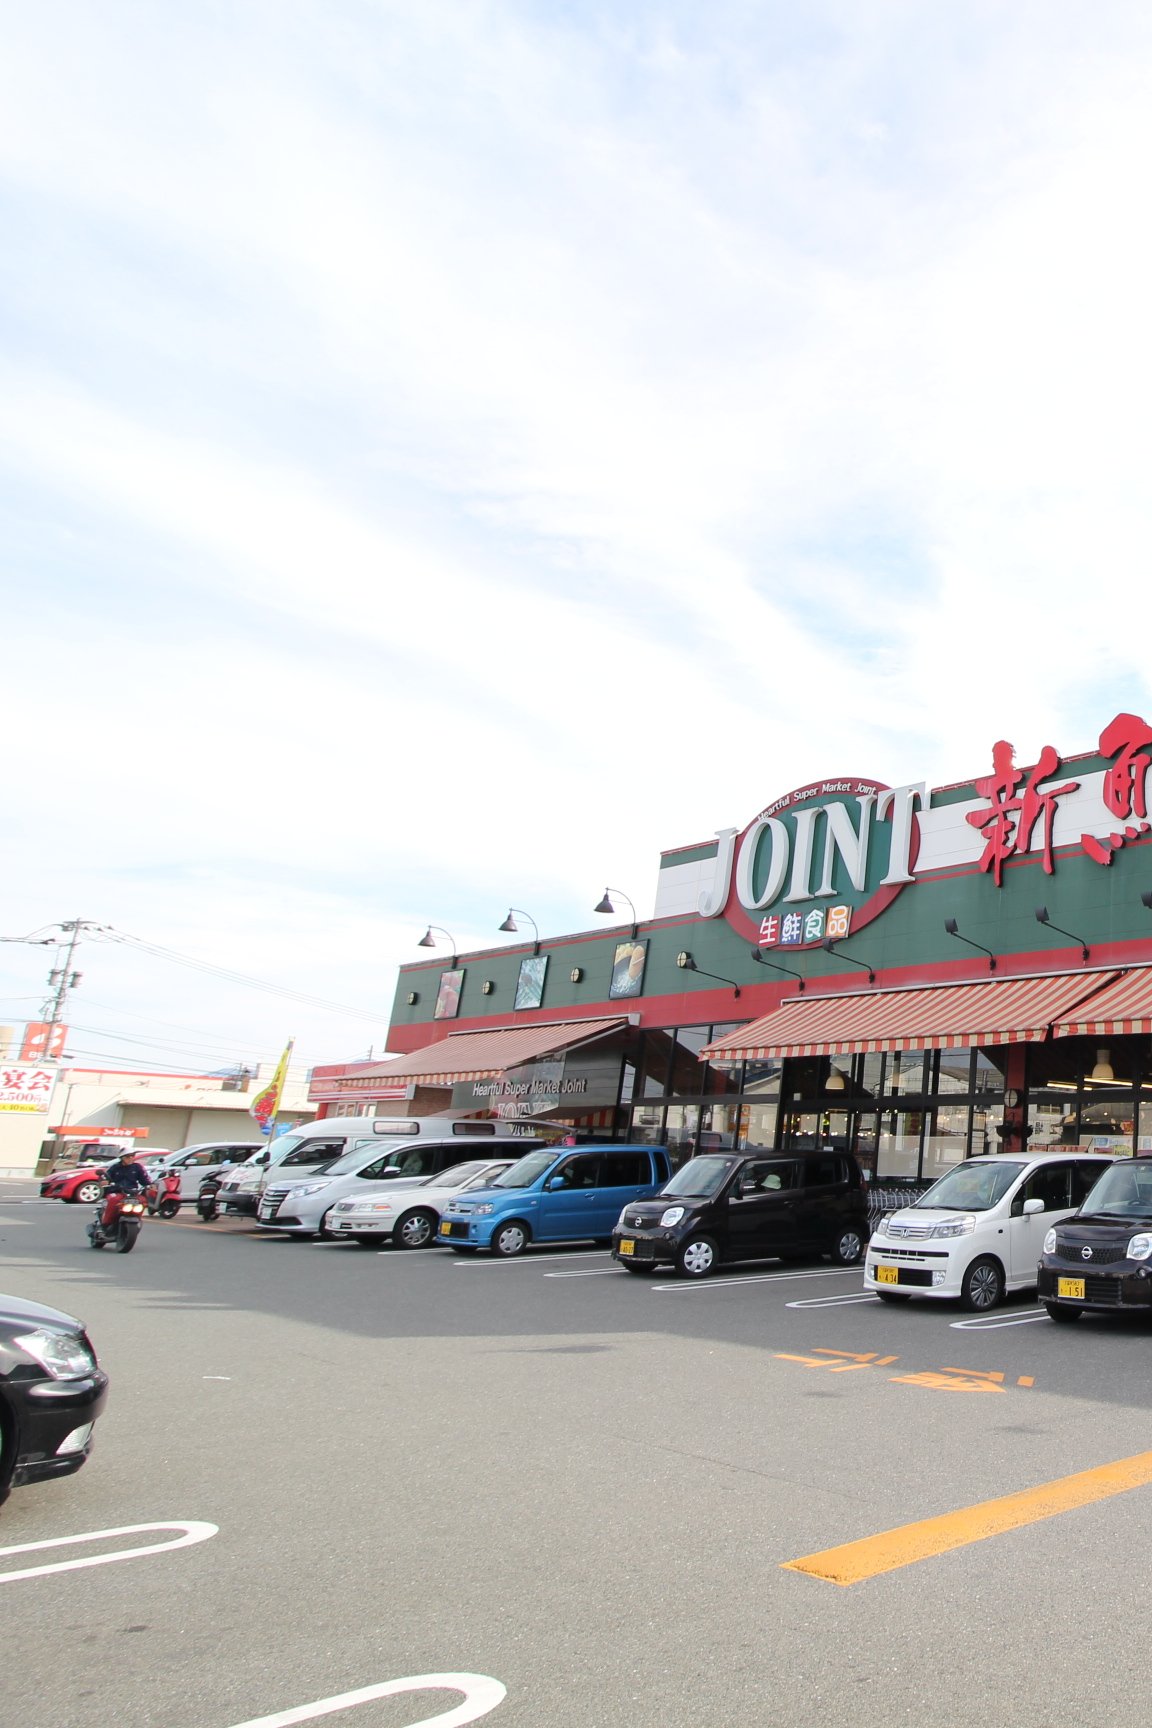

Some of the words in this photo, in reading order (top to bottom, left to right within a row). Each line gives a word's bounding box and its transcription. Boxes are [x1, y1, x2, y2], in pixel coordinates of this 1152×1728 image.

[793, 787, 819, 801] Super
[822, 781, 852, 793] Market
[854, 782, 877, 796] Joint
[698, 781, 927, 918] JOINT
[759, 905, 850, 944] 生鮮食品
[2, 1069, 53, 1091] 宴会
[472, 1083, 503, 1096] Heartful
[505, 1081, 530, 1098] Super
[531, 1080, 560, 1094] Market
[562, 1078, 587, 1093] Joint
